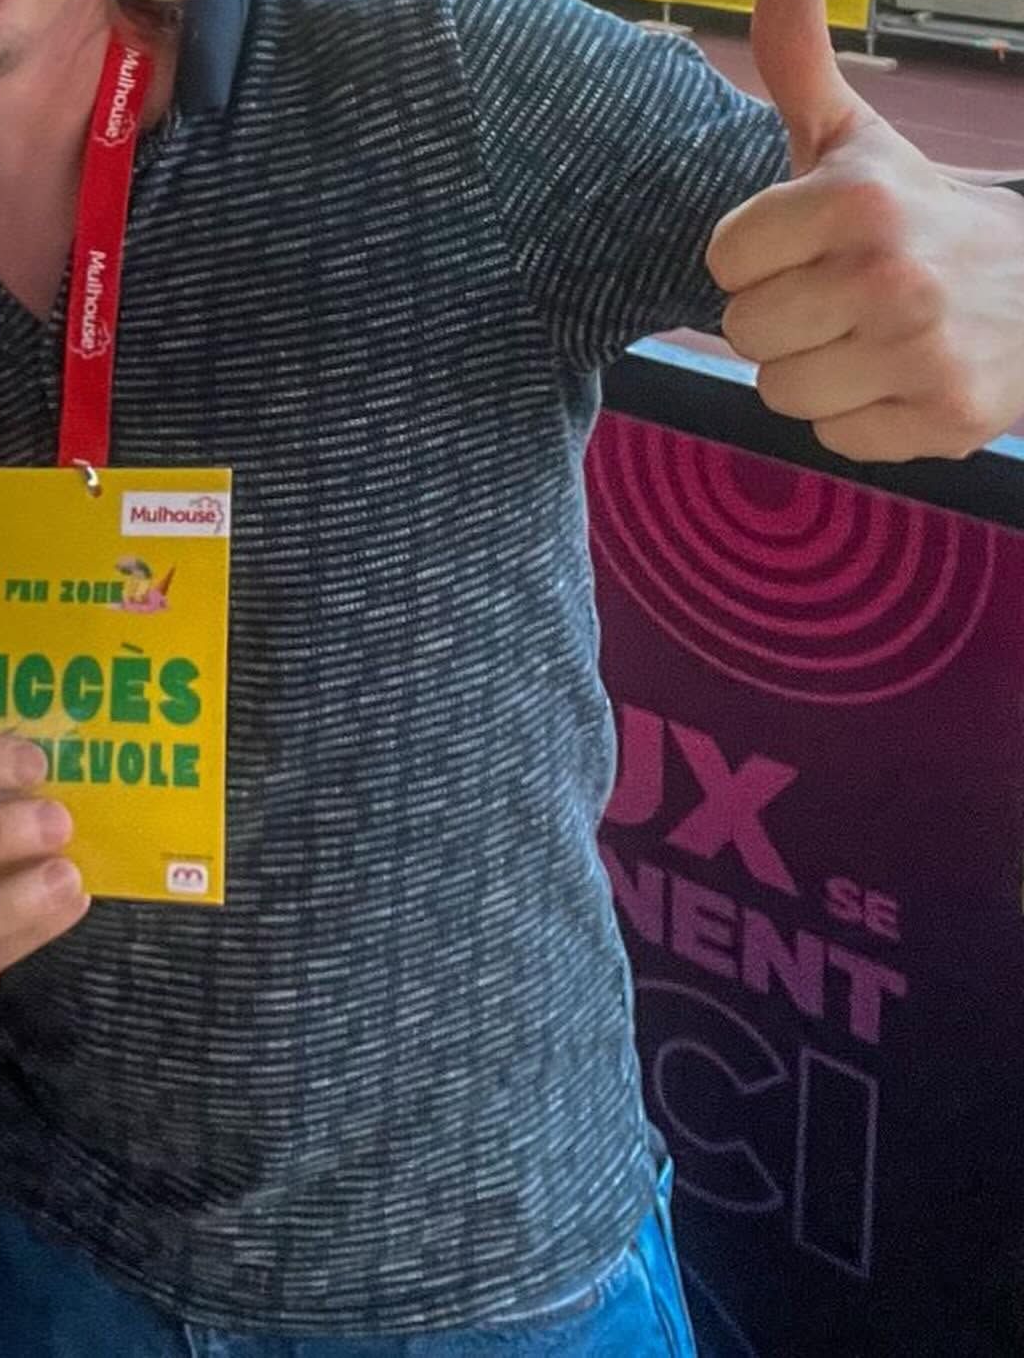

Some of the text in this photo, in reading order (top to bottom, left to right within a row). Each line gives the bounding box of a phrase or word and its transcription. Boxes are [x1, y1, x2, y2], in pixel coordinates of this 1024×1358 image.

[105, 47, 141, 139] Mulhouse
[81, 249, 107, 350] Mulhouse
[130, 505, 216, 524] Mulhouse
[4, 578, 124, 604] FAN ZONE
[824, 877, 901, 941] SE
